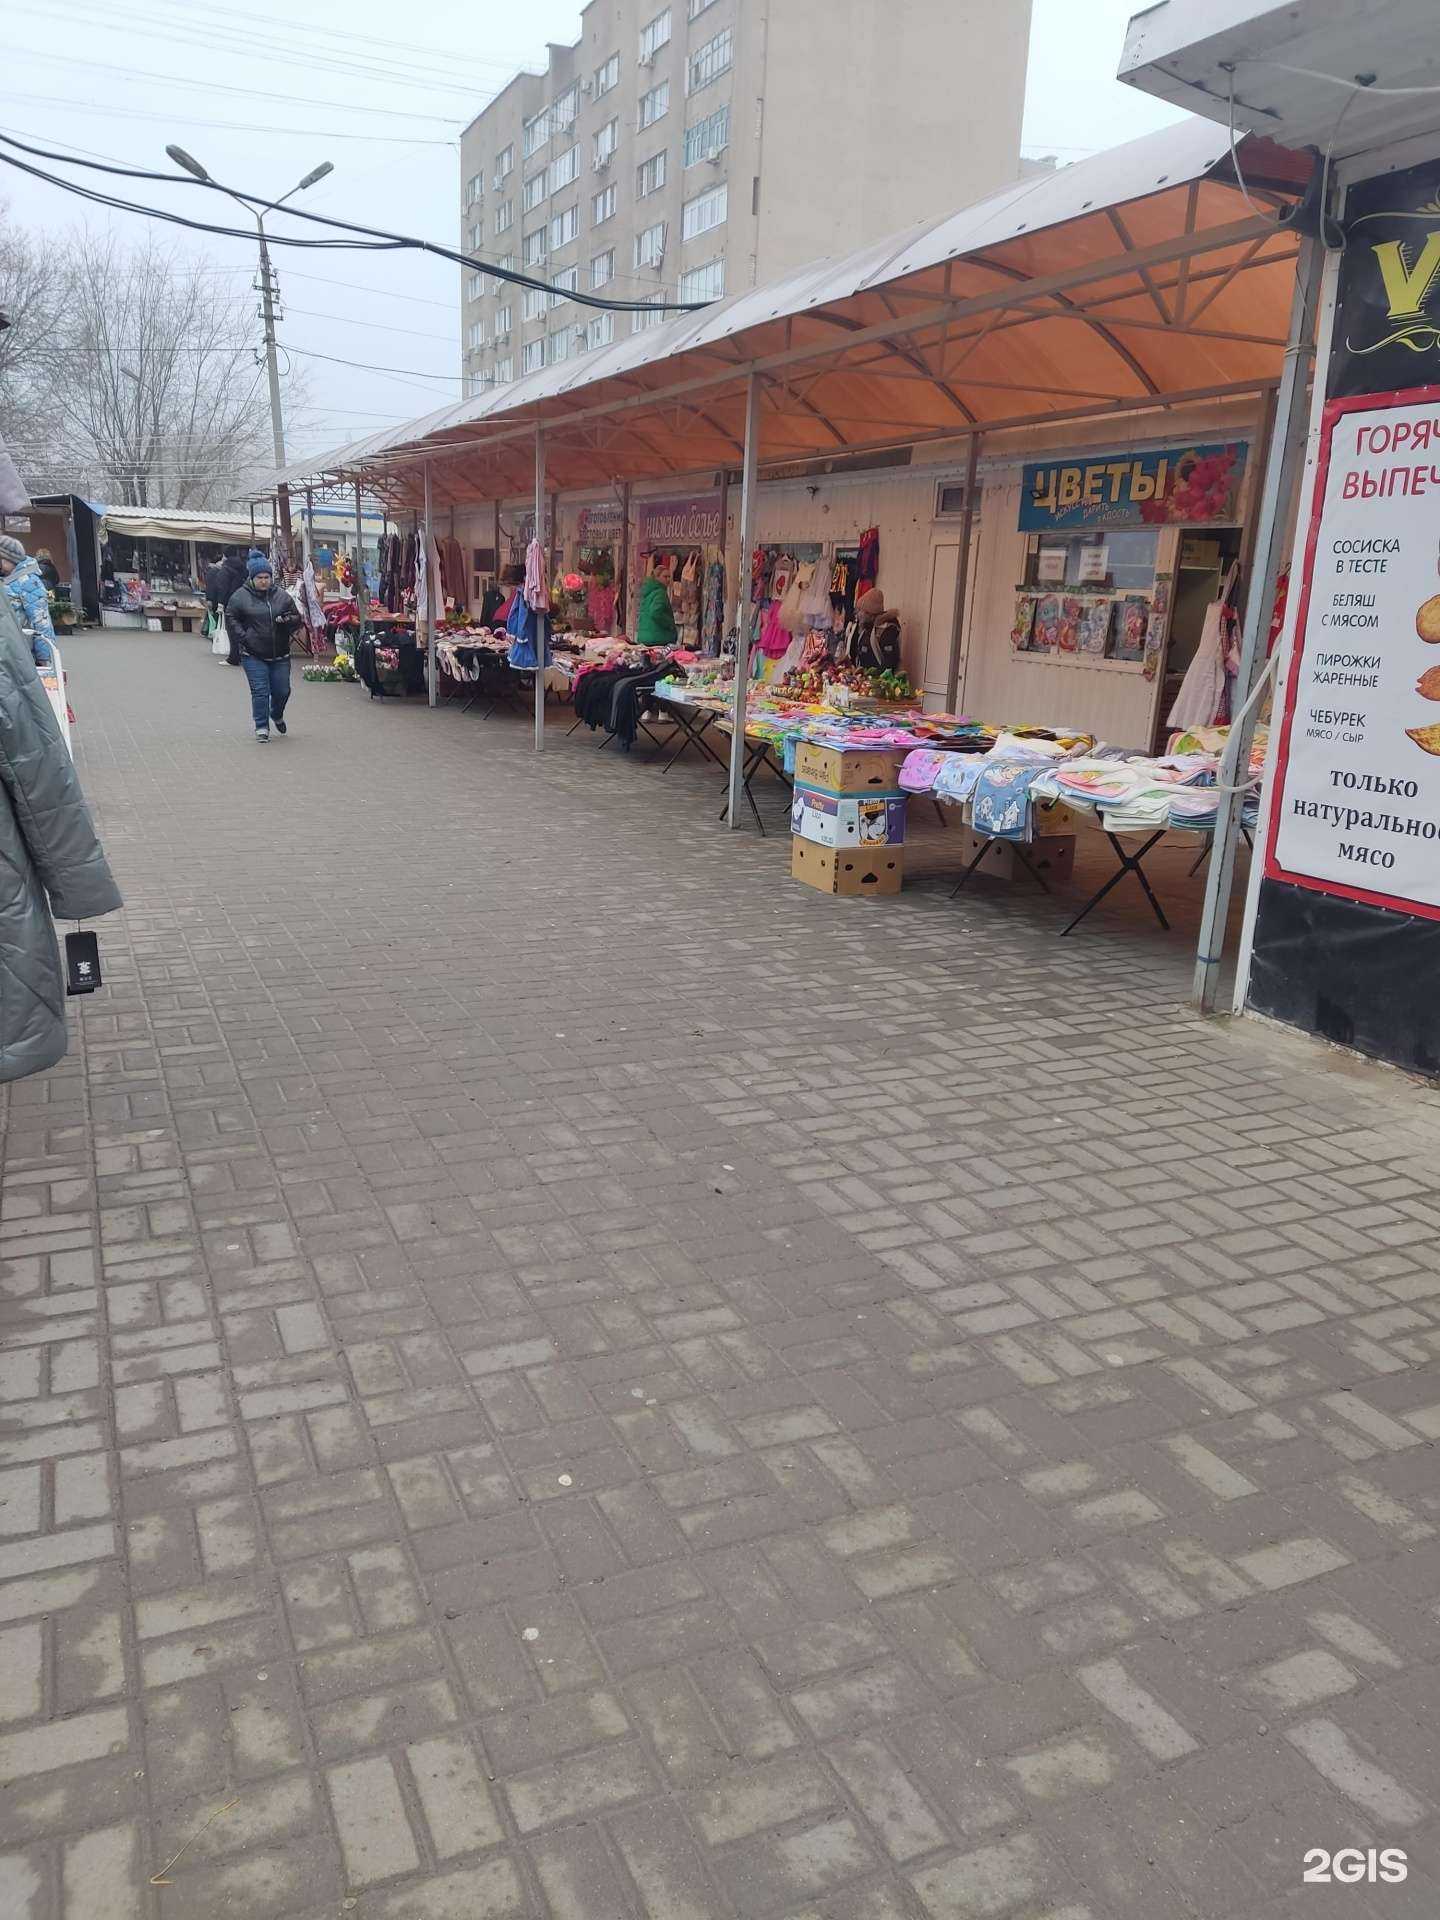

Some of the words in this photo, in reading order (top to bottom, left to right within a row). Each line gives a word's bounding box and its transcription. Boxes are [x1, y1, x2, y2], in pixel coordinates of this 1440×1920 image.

[1032, 459, 1168, 514] ЦВЕТЫ
[1332, 538, 1400, 554] СОСИСКА
[1335, 559, 1344, 574] В
[1349, 558, 1388, 574] ТЕСТЕ
[1332, 593, 1376, 607] БЕЛЯШ
[1321, 614, 1329, 626] С
[1330, 613, 1379, 628] МЯСОМ
[1315, 653, 1381, 669] ПИРОЖКИ
[1312, 671, 1379, 688] ЖАРЕННЫЕ
[1309, 708, 1367, 728] ЧЕБУРЕК
[1306, 728, 1333, 740] МЯСО
[1342, 732, 1364, 743] СЫР
[1330, 770, 1418, 798] только
[1293, 799, 1440, 840] натурально
[1337, 842, 1395, 869] мясо
